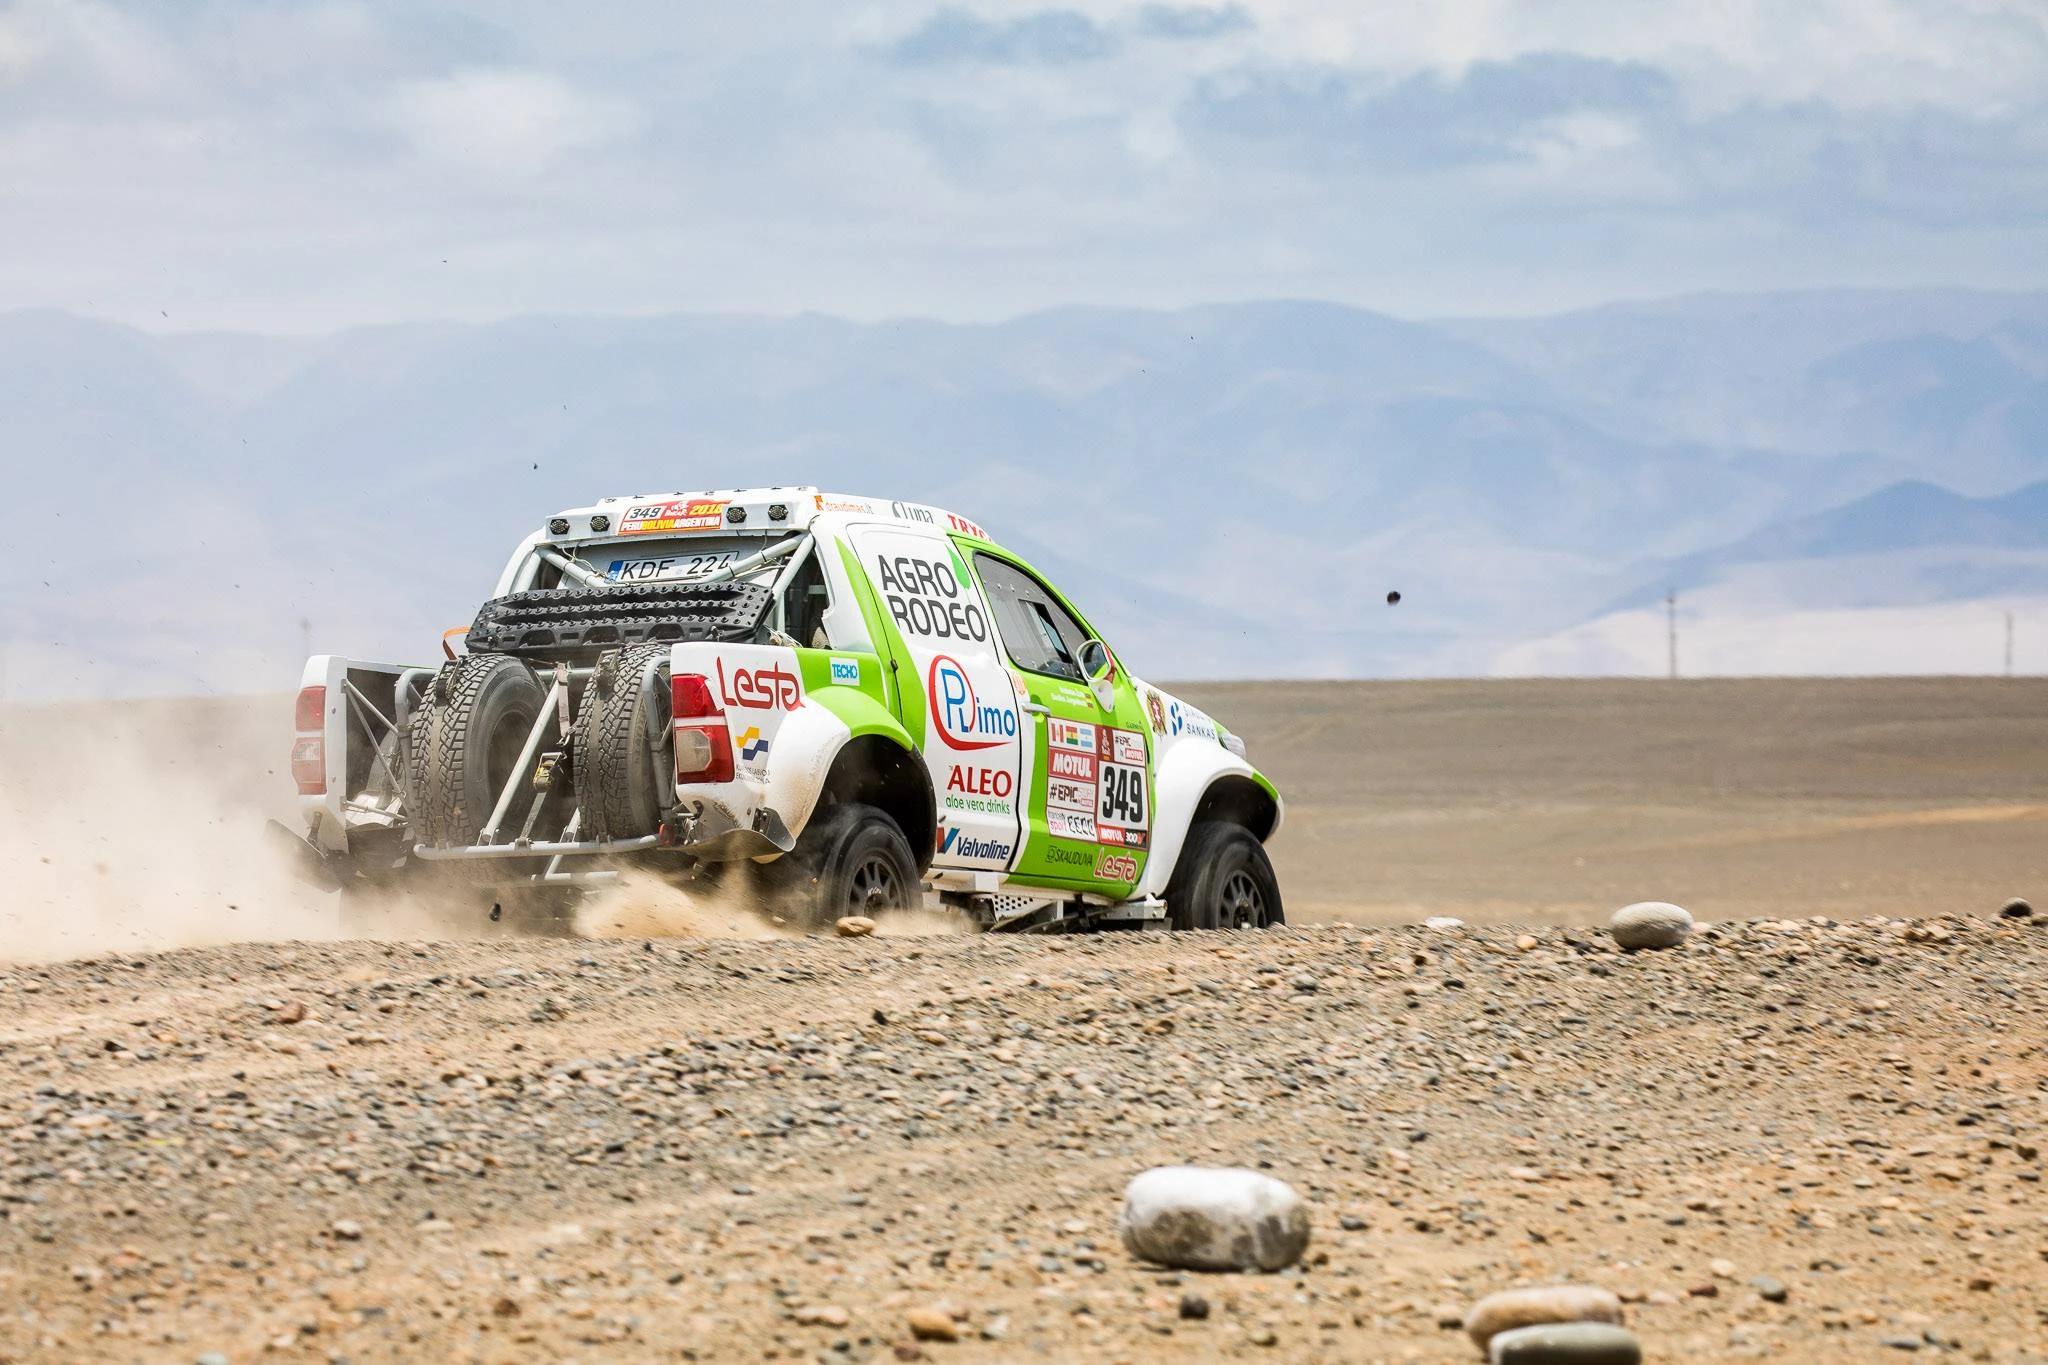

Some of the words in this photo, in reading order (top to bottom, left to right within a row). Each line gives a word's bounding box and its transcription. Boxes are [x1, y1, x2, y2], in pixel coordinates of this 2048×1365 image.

[630, 507, 661, 519] 349
[621, 560, 675, 580] KDF
[878, 555, 957, 598] AGRO
[887, 595, 986, 642] RODEO
[716, 656, 806, 711] Lesta
[832, 664, 858, 679] TECHO
[1052, 753, 1092, 777] MOTUL
[947, 764, 1012, 797] ALEO
[945, 794, 965, 808] aloe
[966, 798, 985, 812] vera
[987, 799, 1011, 815] drinks
[1102, 766, 1143, 823] 349
[1101, 827, 1124, 842] MOTUL
[956, 836, 1011, 860] Valvoline
[1094, 847, 1138, 883] Lesta
